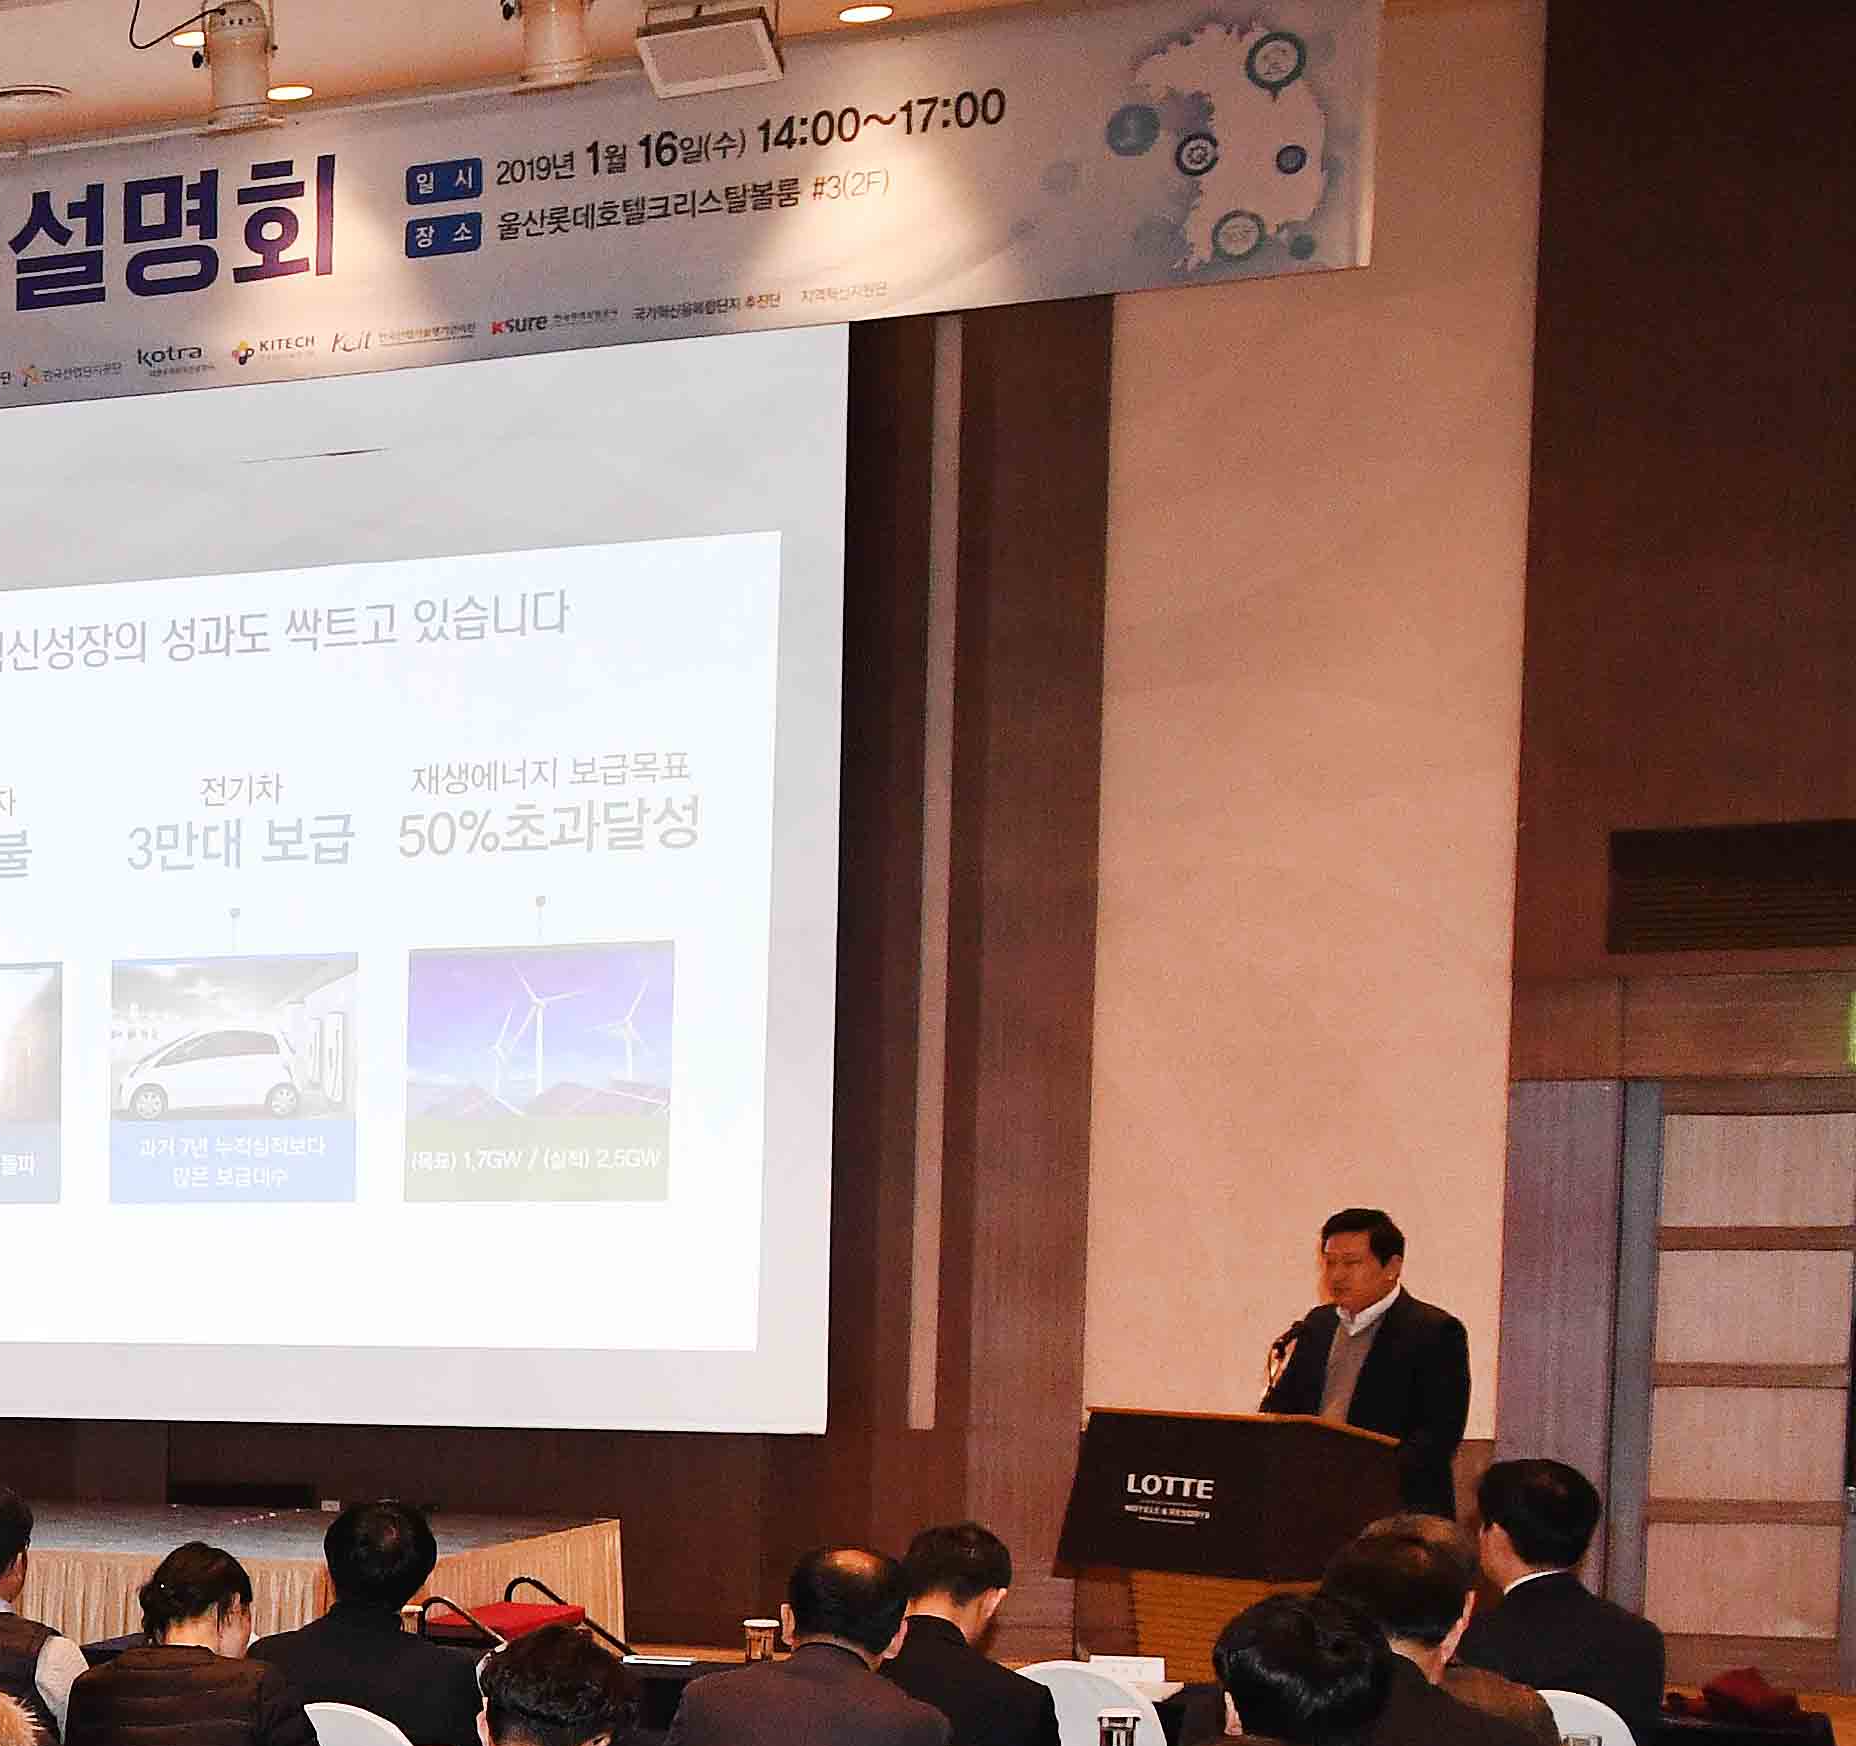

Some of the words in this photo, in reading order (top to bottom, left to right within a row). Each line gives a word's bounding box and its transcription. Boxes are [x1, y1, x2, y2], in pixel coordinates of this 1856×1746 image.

[496, 151, 576, 186] 2019년
[585, 140, 628, 176] 1월
[638, 128, 747, 169] 16일(수)
[497, 177, 801, 241] 울산롯데호텔크리스탈볼룸
[812, 168, 891, 202] #3(2F)
[137, 346, 203, 368] kotra
[259, 335, 315, 352] KITECH
[160, 611, 272, 662] 성과도
[283, 603, 399, 652] 싹트고
[413, 588, 571, 644] 있습니다
[199, 770, 284, 807] 전기차
[409, 755, 559, 796] 재생에너지
[567, 750, 692, 786] 보급목표
[127, 816, 245, 872] 3만대
[261, 811, 356, 865] 보급
[1126, 1473, 1216, 1500] LOTTE
